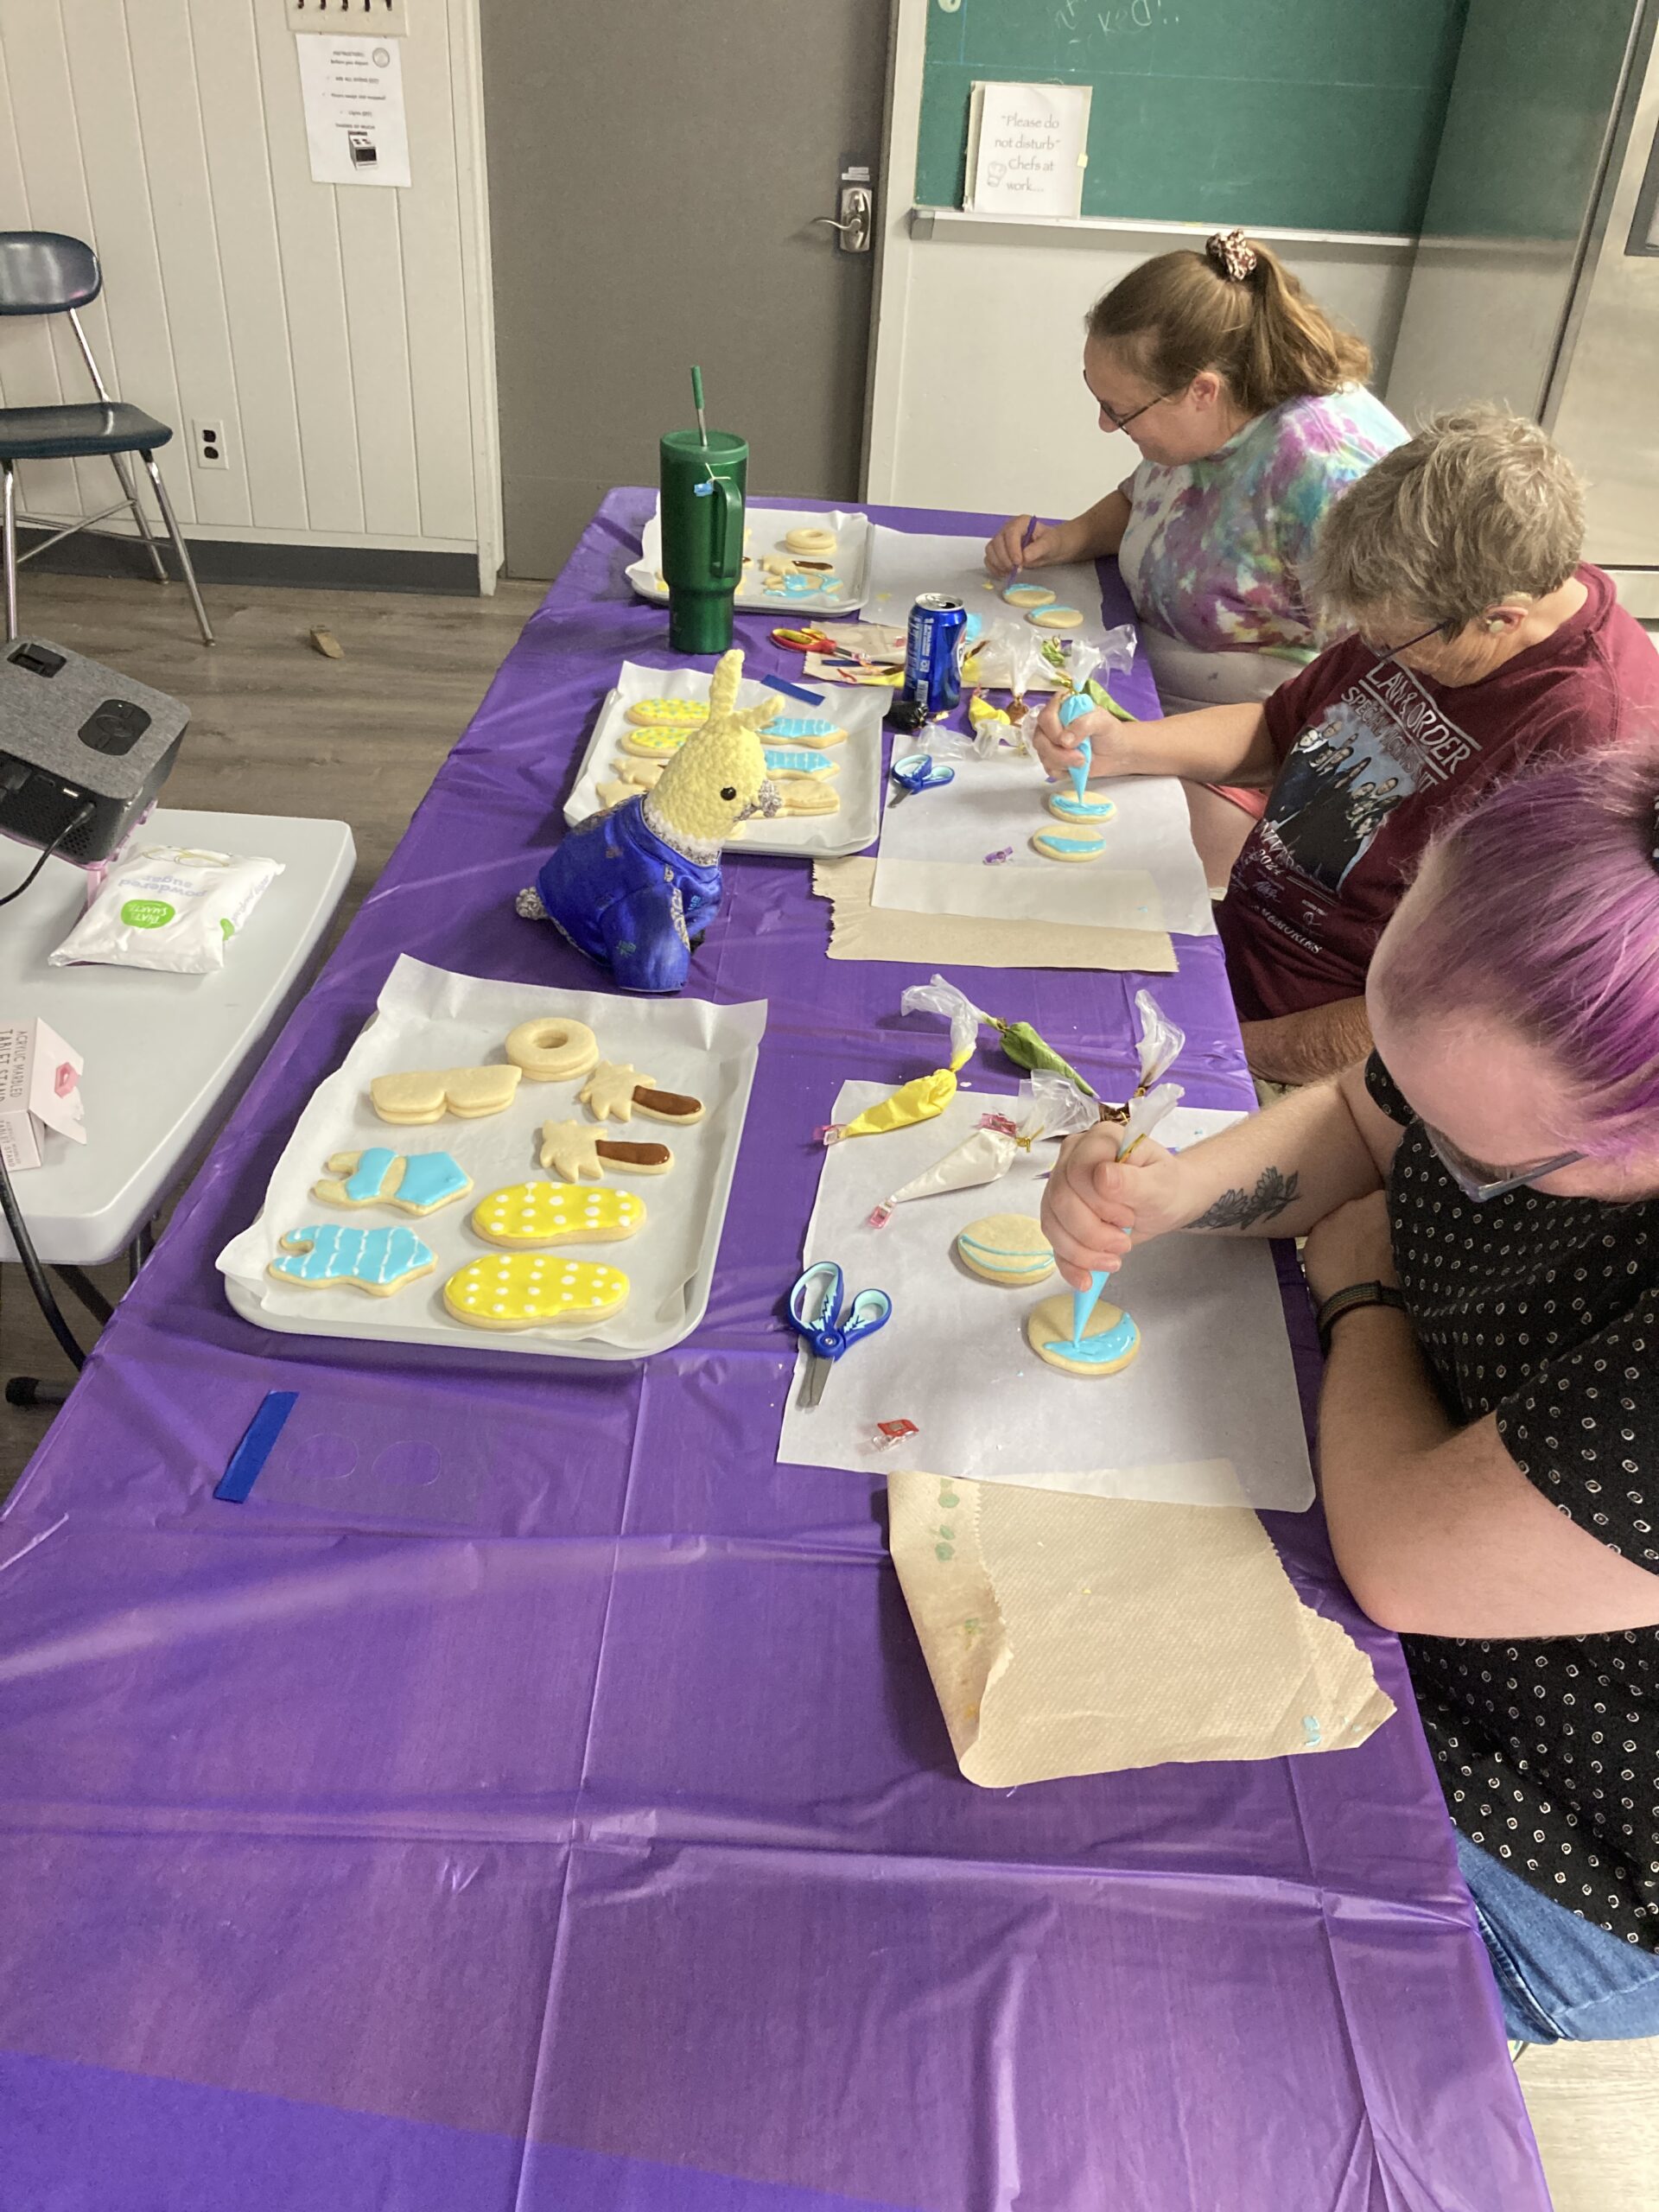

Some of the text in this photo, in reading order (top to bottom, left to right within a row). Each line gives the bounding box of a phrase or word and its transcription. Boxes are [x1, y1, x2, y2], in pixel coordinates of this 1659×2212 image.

[1044, 114, 1059, 129] do
[995, 138, 1013, 148] not
[1007, 156, 1053, 171] Chefs at
[1365, 662, 1408, 706] LAW
[1406, 702, 1471, 774] ORDER
[1258, 849, 1287, 876] 2024
[118, 880, 207, 898] powdered
[142, 874, 193, 889] sugar
[13, 1031, 28, 1063] ACRYLIC
